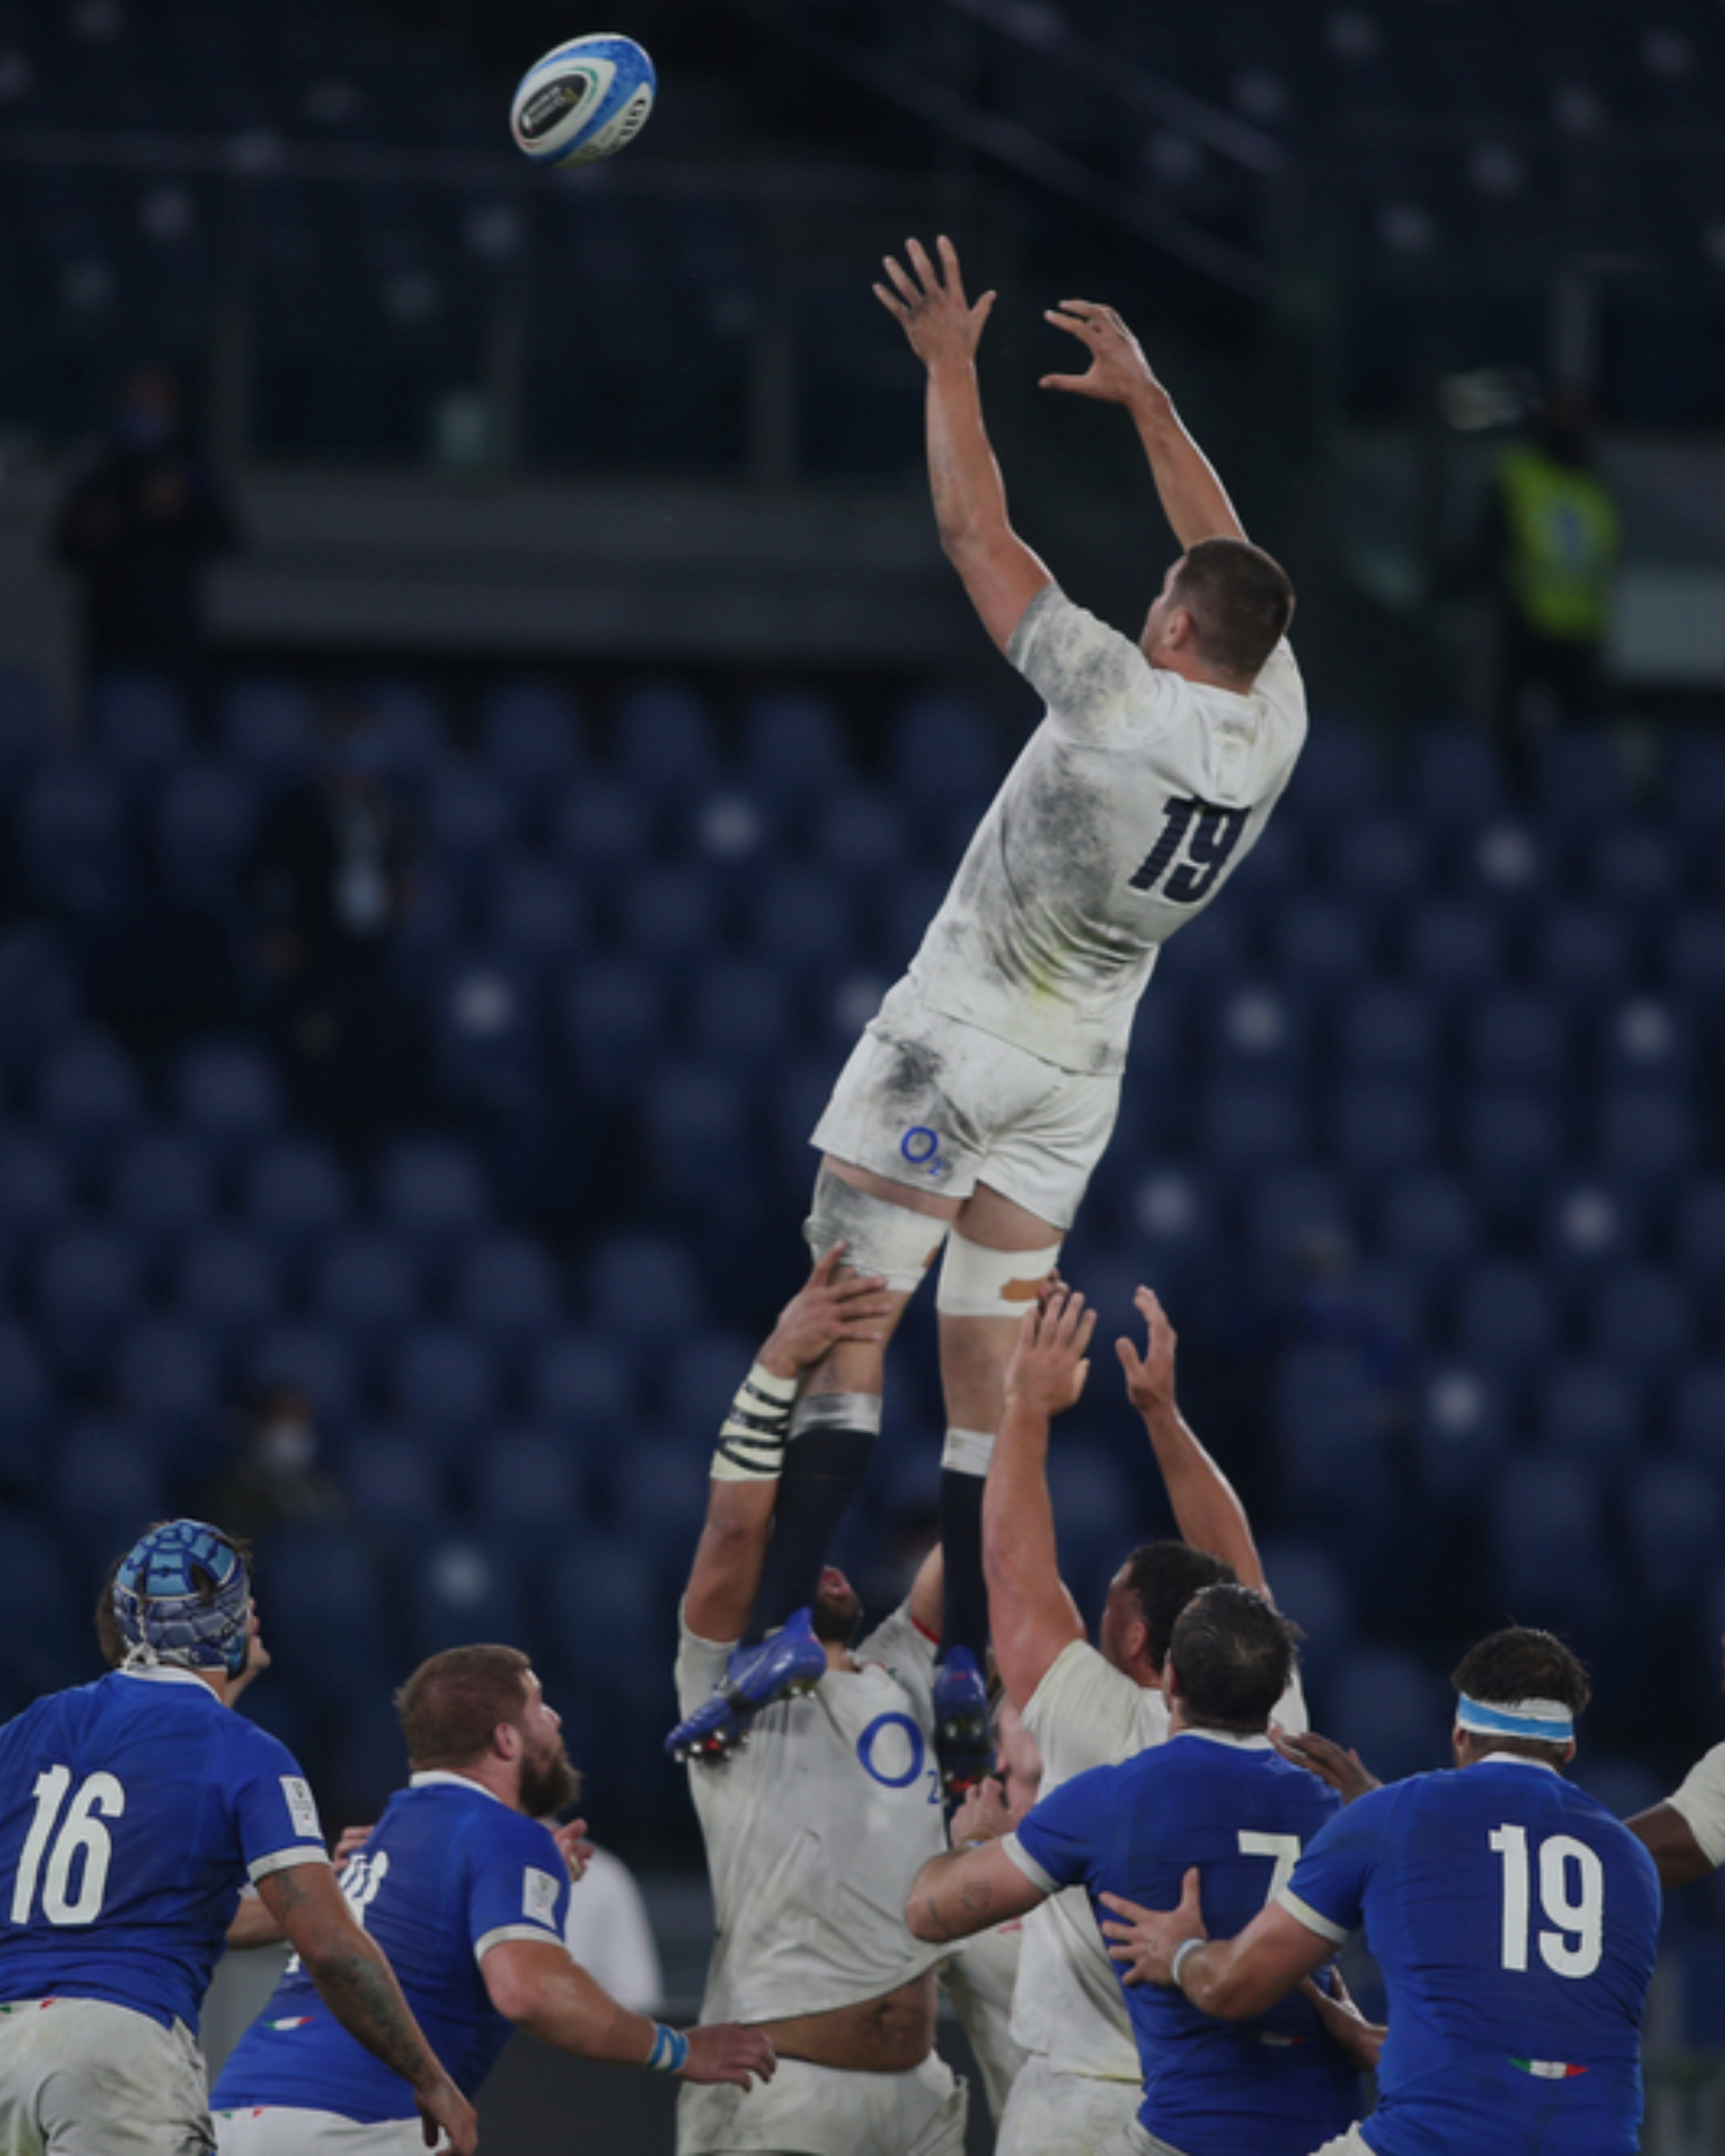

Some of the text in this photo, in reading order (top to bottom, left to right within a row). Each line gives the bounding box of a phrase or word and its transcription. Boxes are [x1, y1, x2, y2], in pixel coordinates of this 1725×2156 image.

[1128, 794, 1252, 902] 19
[10, 1763, 125, 1924] 16
[1237, 1829, 1301, 1907] 7
[1488, 1823, 1603, 1979] 19
